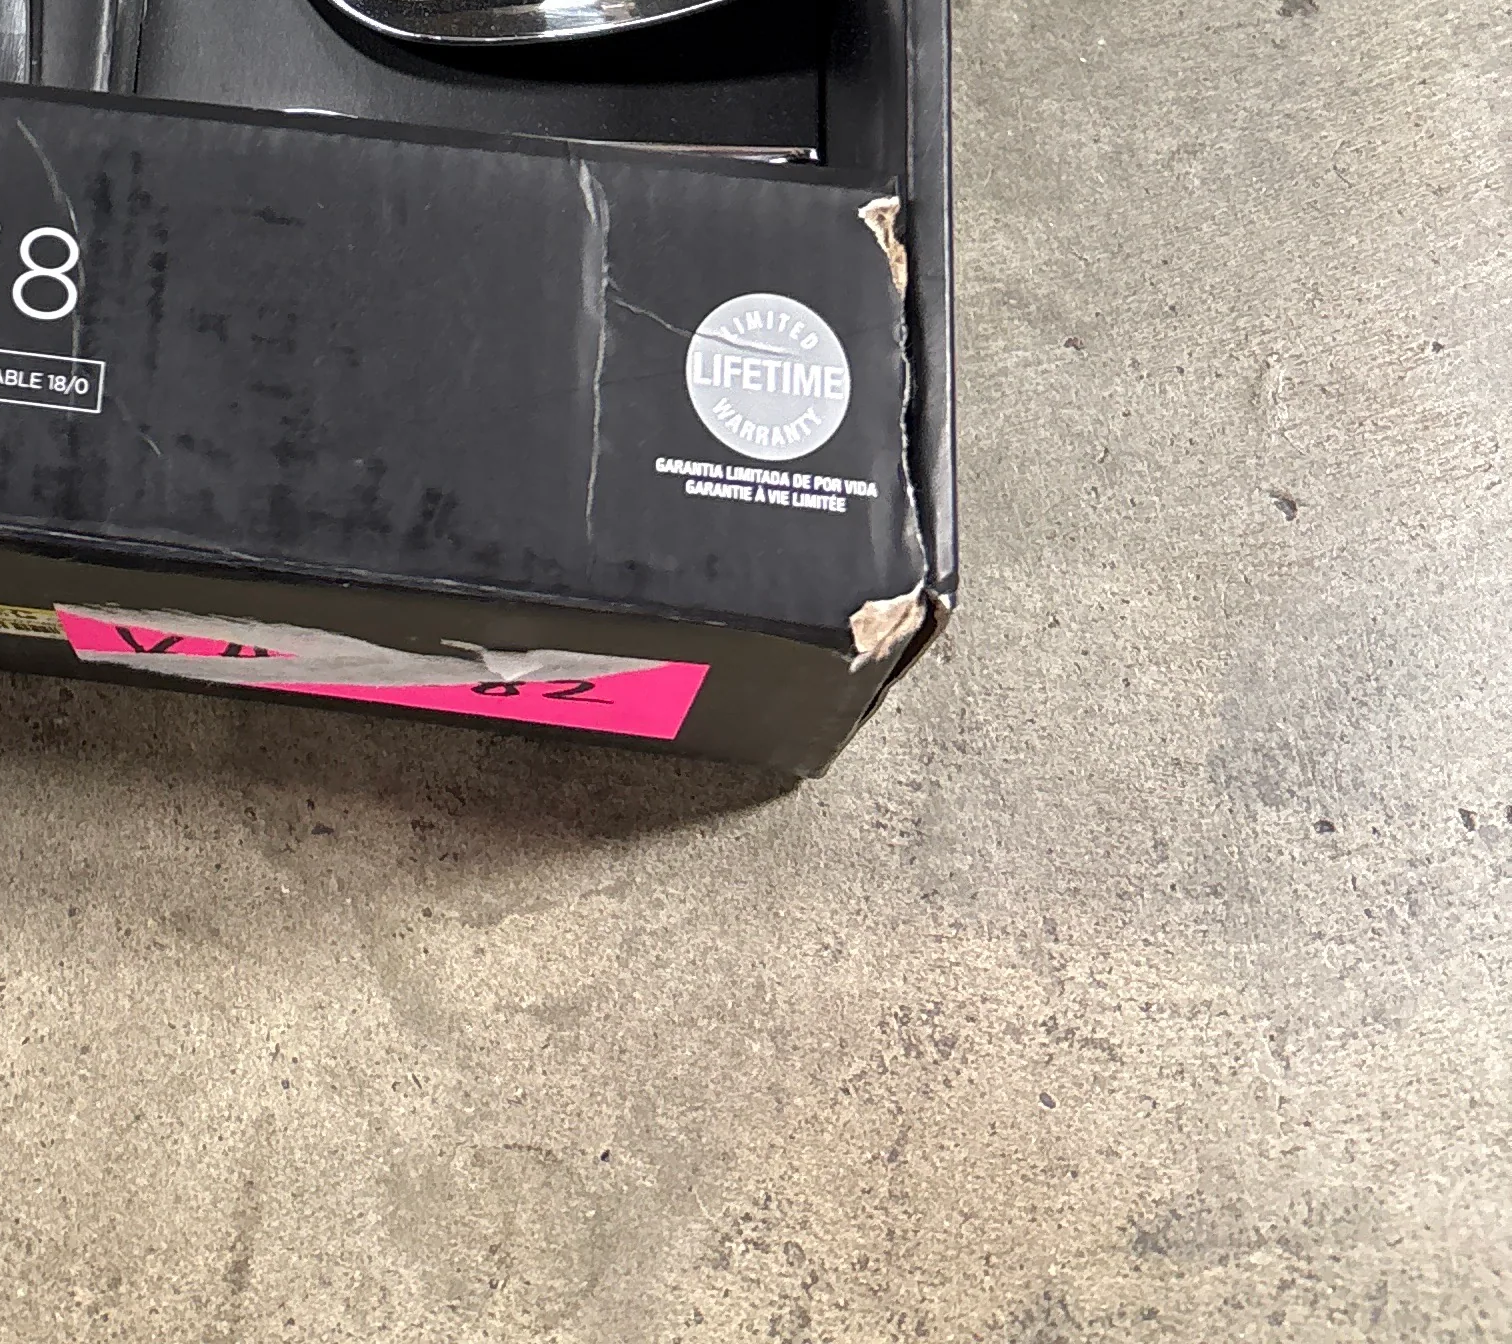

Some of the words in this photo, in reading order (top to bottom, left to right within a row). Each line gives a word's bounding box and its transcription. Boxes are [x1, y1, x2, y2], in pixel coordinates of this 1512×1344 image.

[12, 227, 80, 320] 8
[718, 310, 819, 350] LIMITED
[47, 374, 89, 395] 18/0
[692, 351, 845, 400] LIFETIME
[712, 397, 822, 448] WARRANTY
[656, 458, 723, 479] GARANTIA
[726, 466, 789, 487] LIMITADA
[793, 474, 811, 489] DE
[814, 476, 842, 493] POR
[845, 480, 878, 497] VIDA
[686, 480, 752, 501] GARANTIE
[755, 486, 765, 502] À
[768, 490, 789, 505] VIE
[792, 492, 846, 512] LIMITÉE
